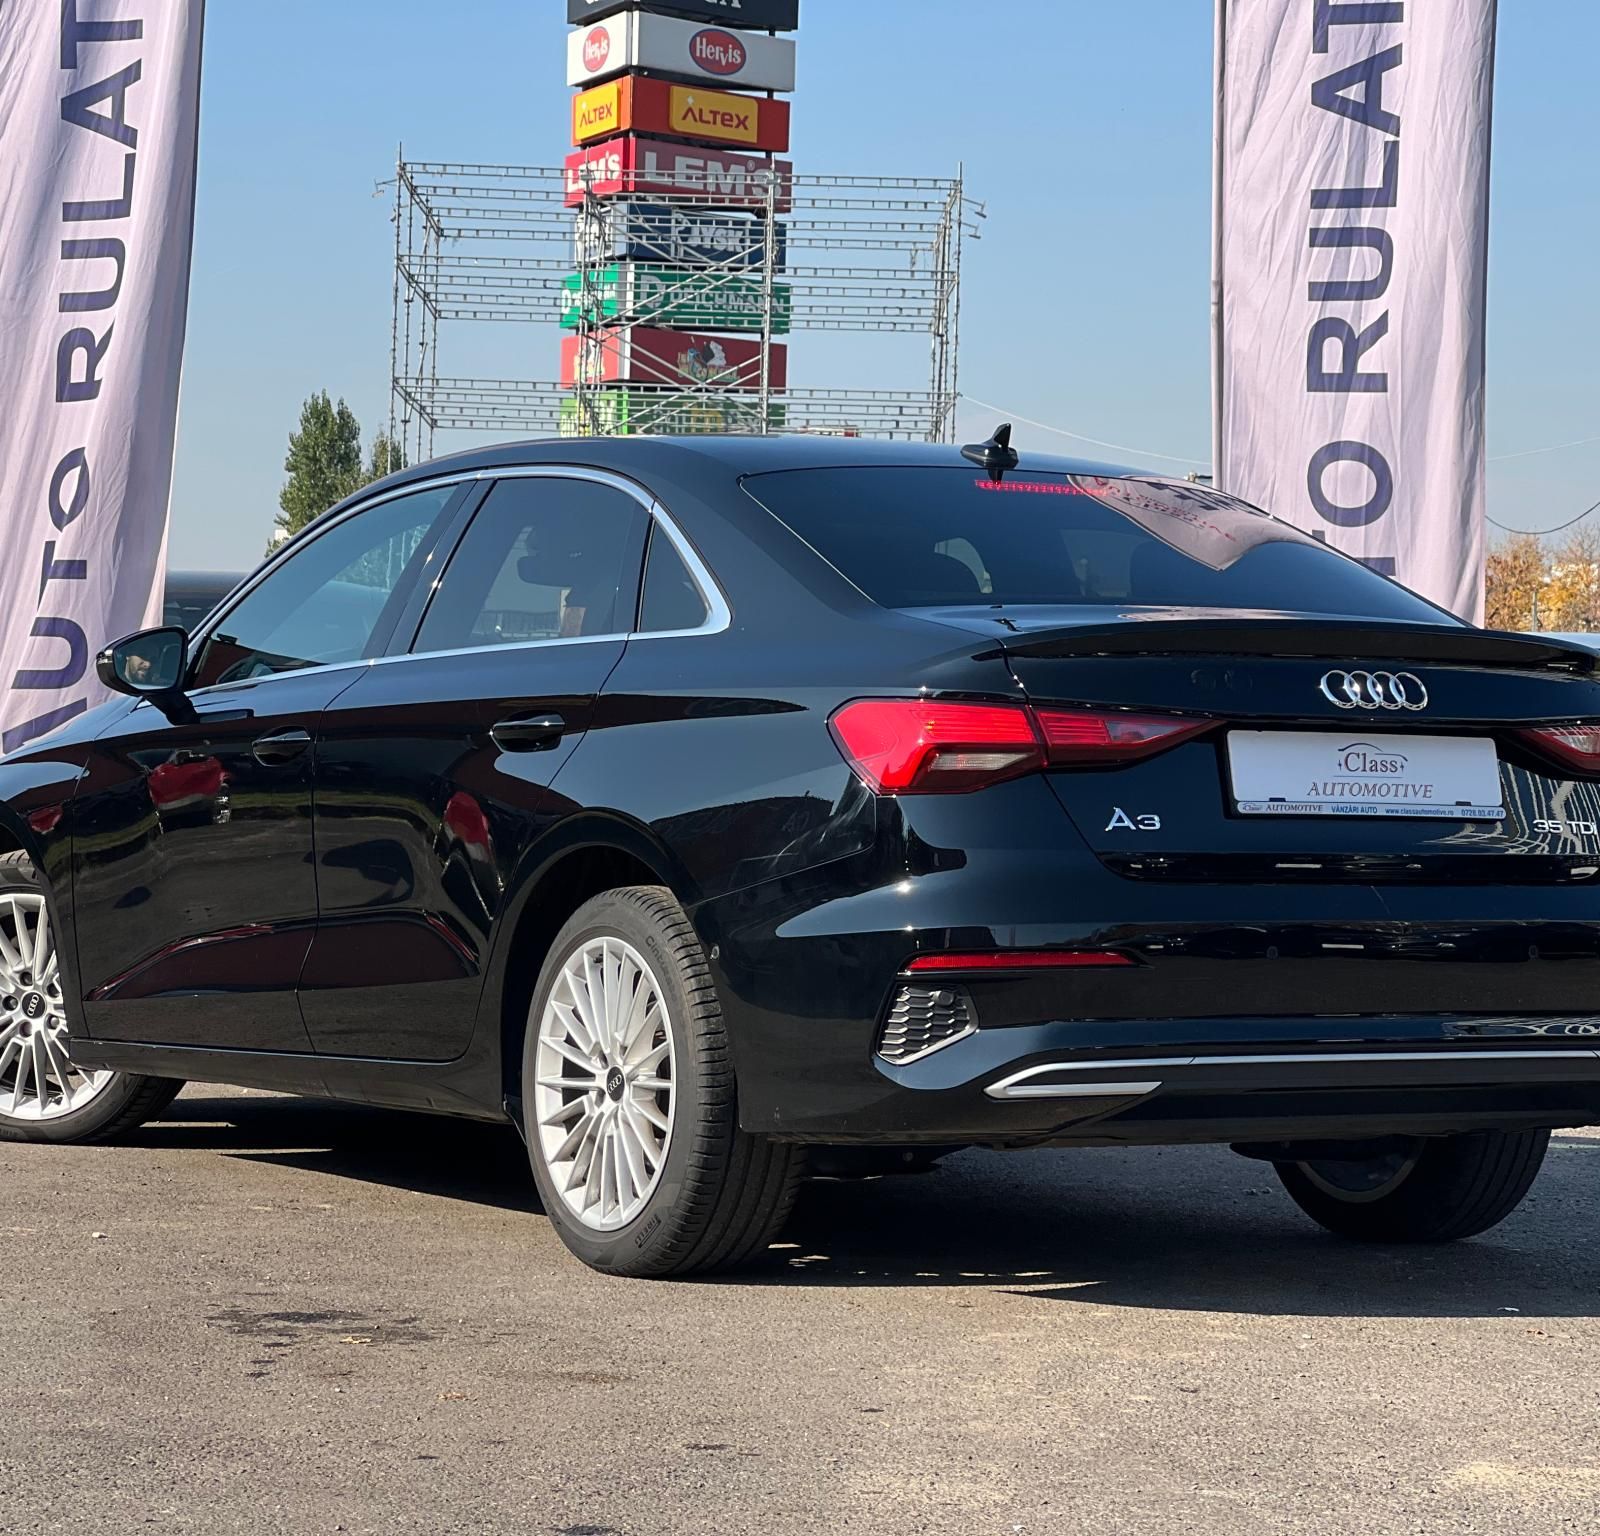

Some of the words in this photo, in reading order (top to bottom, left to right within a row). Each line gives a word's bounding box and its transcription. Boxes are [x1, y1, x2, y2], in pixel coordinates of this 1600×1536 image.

[695, 37, 742, 66] Hervis
[1343, 752, 1399, 774] Class
[1307, 781, 1434, 799] AUTOMOTIVE
[1104, 806, 1160, 831] A3
[1265, 803, 1323, 813] AUTOMOTIVE
[1360, 806, 1378, 814] AUTO
[1532, 819, 1563, 834] 35
